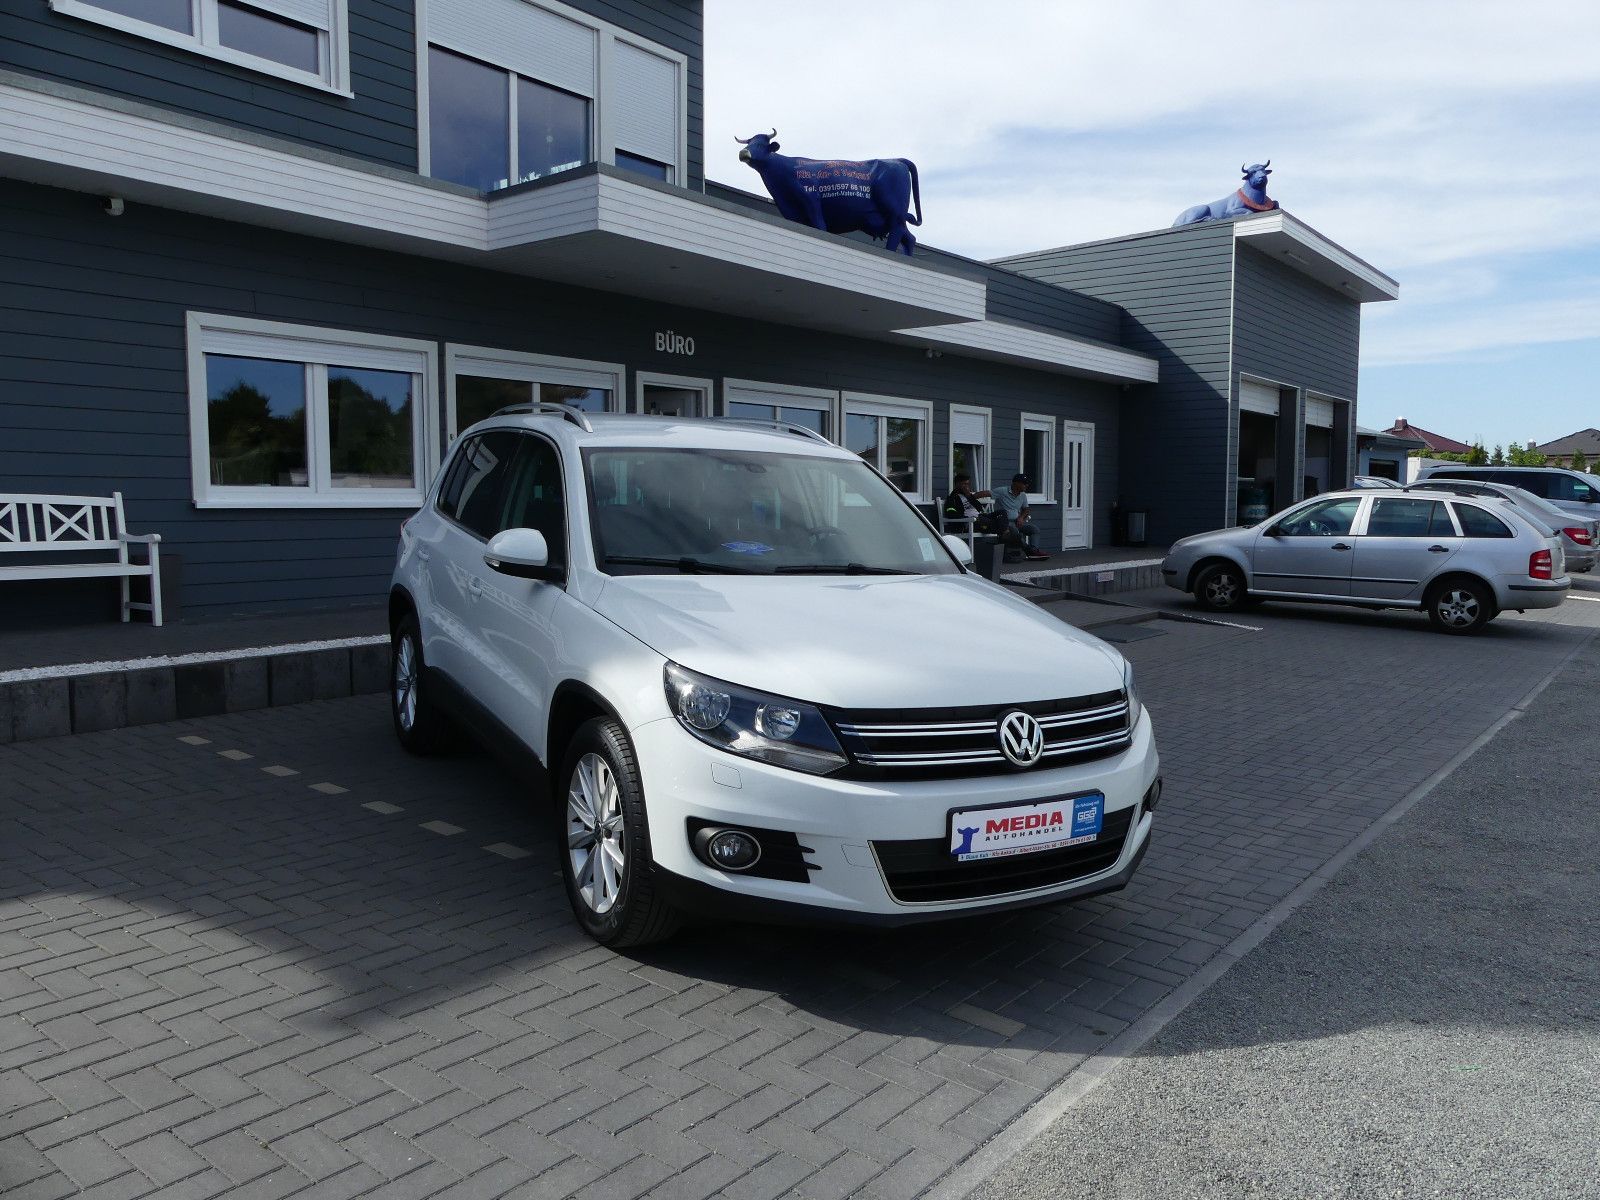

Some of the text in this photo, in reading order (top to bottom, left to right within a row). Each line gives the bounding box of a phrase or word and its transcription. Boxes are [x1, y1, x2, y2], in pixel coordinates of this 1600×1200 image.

[819, 183, 849, 192] 0391/597
[655, 330, 695, 356] BÜRO
[1000, 711, 1043, 766] VW
[985, 826, 1063, 842] AUTOHANDEL
[986, 811, 1063, 834] MEDIA
